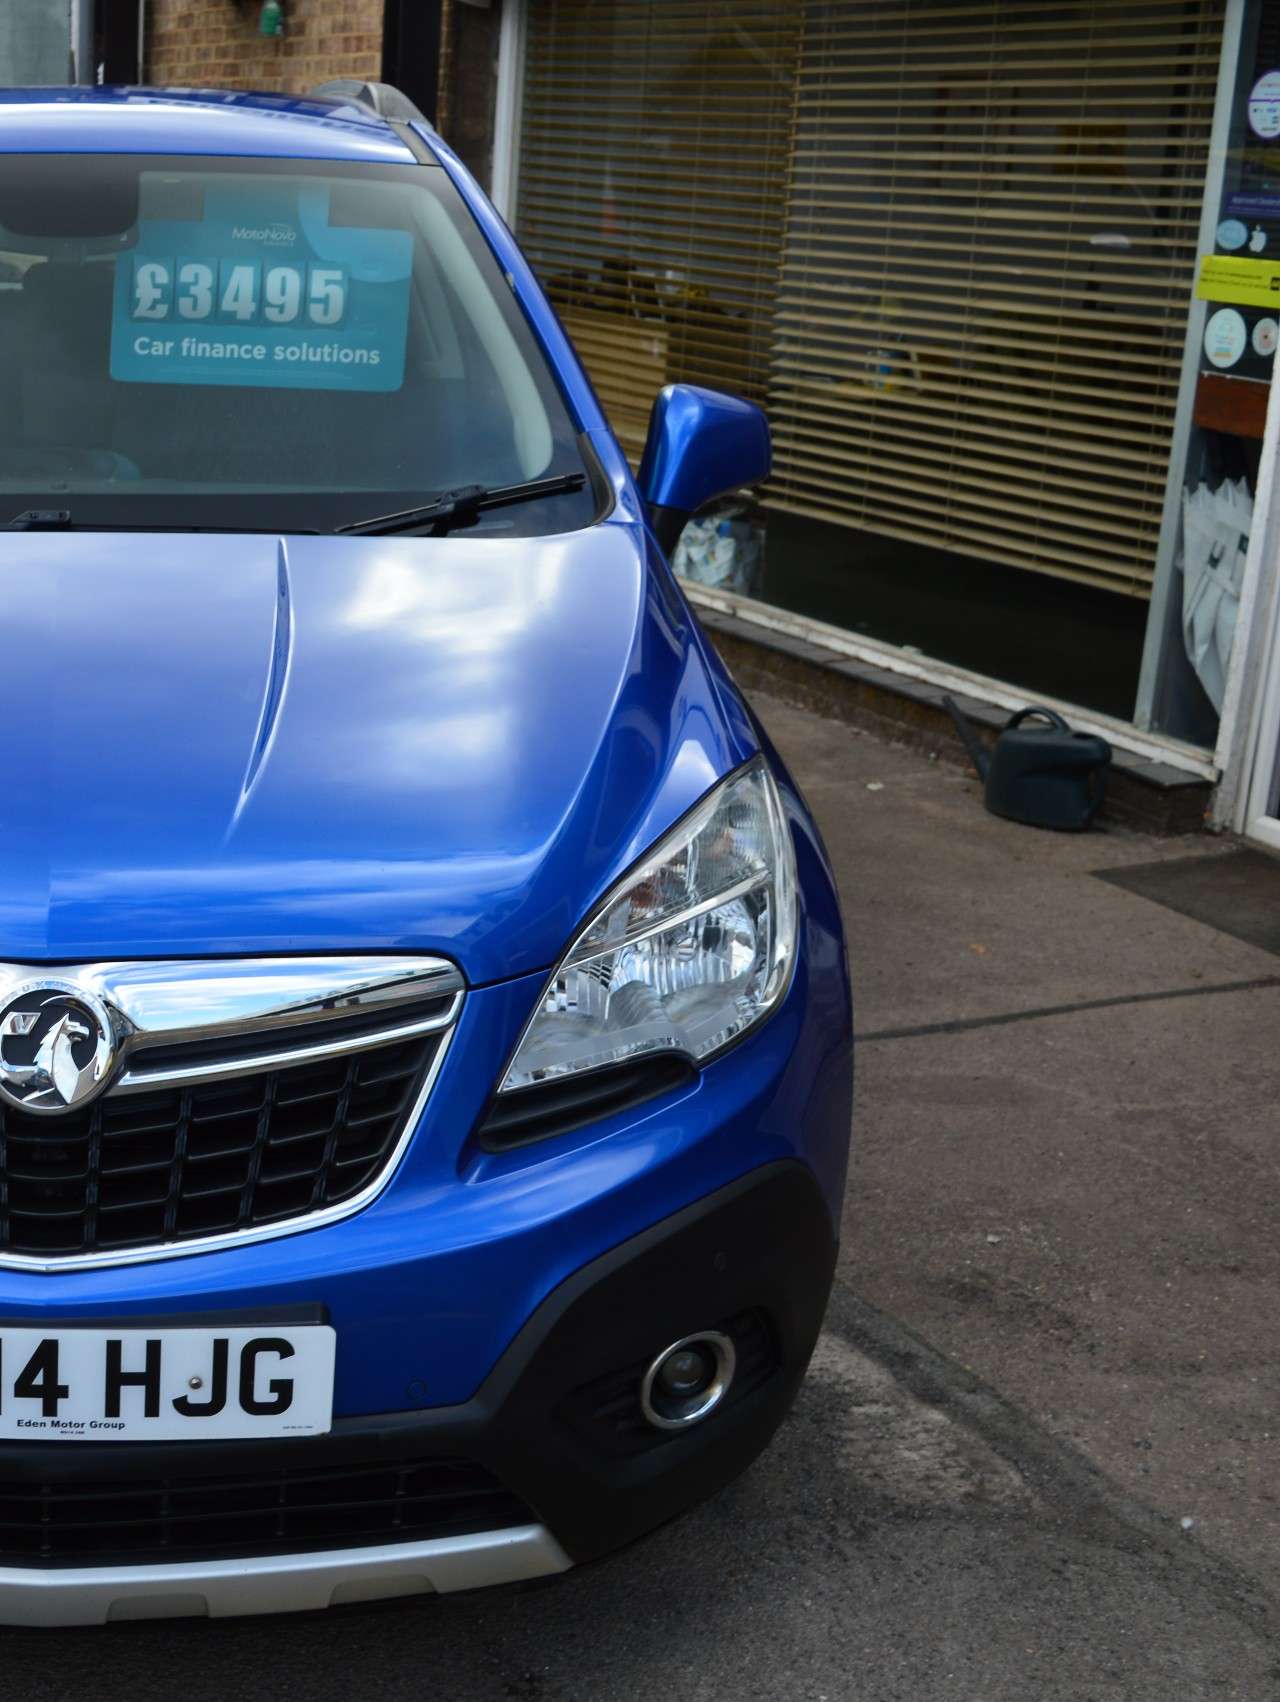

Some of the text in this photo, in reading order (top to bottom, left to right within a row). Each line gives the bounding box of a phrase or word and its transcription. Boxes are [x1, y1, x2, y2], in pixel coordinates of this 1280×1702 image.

[232, 226, 297, 241] MotoNovo
[133, 263, 344, 325] £3495
[134, 337, 380, 364] Car finance solutions
[104, 1337, 296, 1419] HJG
[17, 1419, 125, 1430] Eden Motor Group
